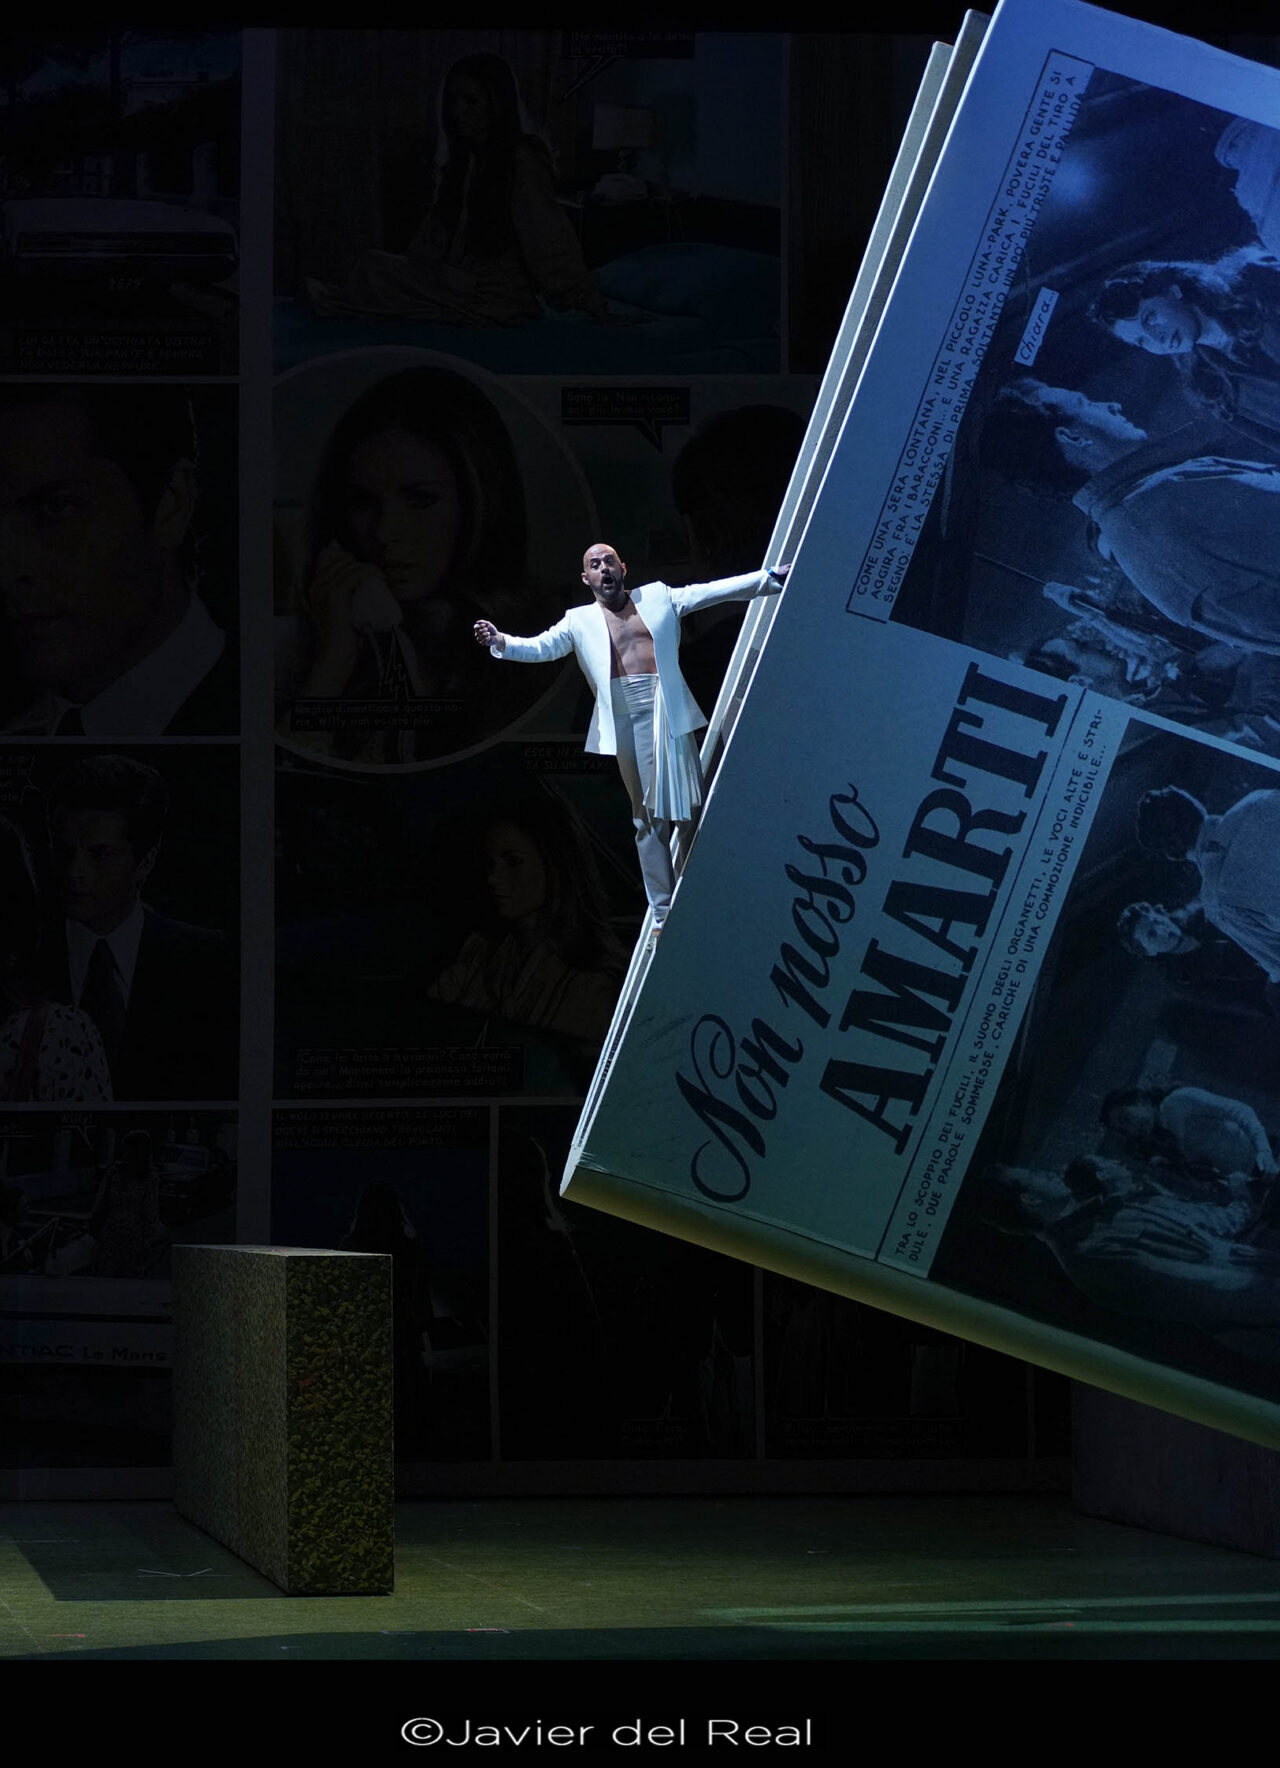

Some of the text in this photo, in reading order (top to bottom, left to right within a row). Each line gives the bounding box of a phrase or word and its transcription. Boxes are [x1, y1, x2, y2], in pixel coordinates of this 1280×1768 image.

[857, 556, 879, 596] COME
[873, 519, 894, 551] UNA
[890, 474, 910, 513] SERA
[934, 359, 952, 385] NEL
[948, 294, 976, 353] PICCOLO
[1008, 140, 1036, 198] POVERA
[1032, 90, 1056, 136] GENTE
[1049, 70, 1062, 86] SI
[870, 546, 898, 600] AGGIRA
[891, 514, 910, 541] FRA
[947, 361, 966, 391] UNA
[959, 291, 993, 356] RAGAZZA
[988, 232, 1016, 285] CARICA
[1016, 164, 1042, 209] FUCILI
[1035, 134, 1055, 160] DEL
[1047, 92, 1069, 127] TIRO
[910, 513, 925, 532] LA
[919, 452, 946, 507] STESSA
[942, 429, 955, 444] DI
[676, 1014, 803, 1201] Non
[819, 662, 1068, 1154] AMARTI
[894, 1232, 912, 1255] TRA
[906, 1211, 919, 1228] LO
[916, 1148, 943, 1207] SCOPPIO
[937, 1121, 954, 1144] DEI
[968, 1053, 980, 1063] IL
[976, 1002, 997, 1050] SUONO
[994, 959, 1013, 997] DEGLI
[1040, 847, 1054, 865] LE
[1051, 808, 1069, 841] VOCI
[1066, 768, 1083, 804] ALTE
[925, 1190, 943, 1217] DUE
[939, 1131, 966, 1185] PAROLE
[992, 979, 1021, 1041] CARICHE
[1015, 958, 1029, 974] DI
[1022, 925, 1042, 954] UNA
[1036, 835, 1075, 921] COMMOZIONE
